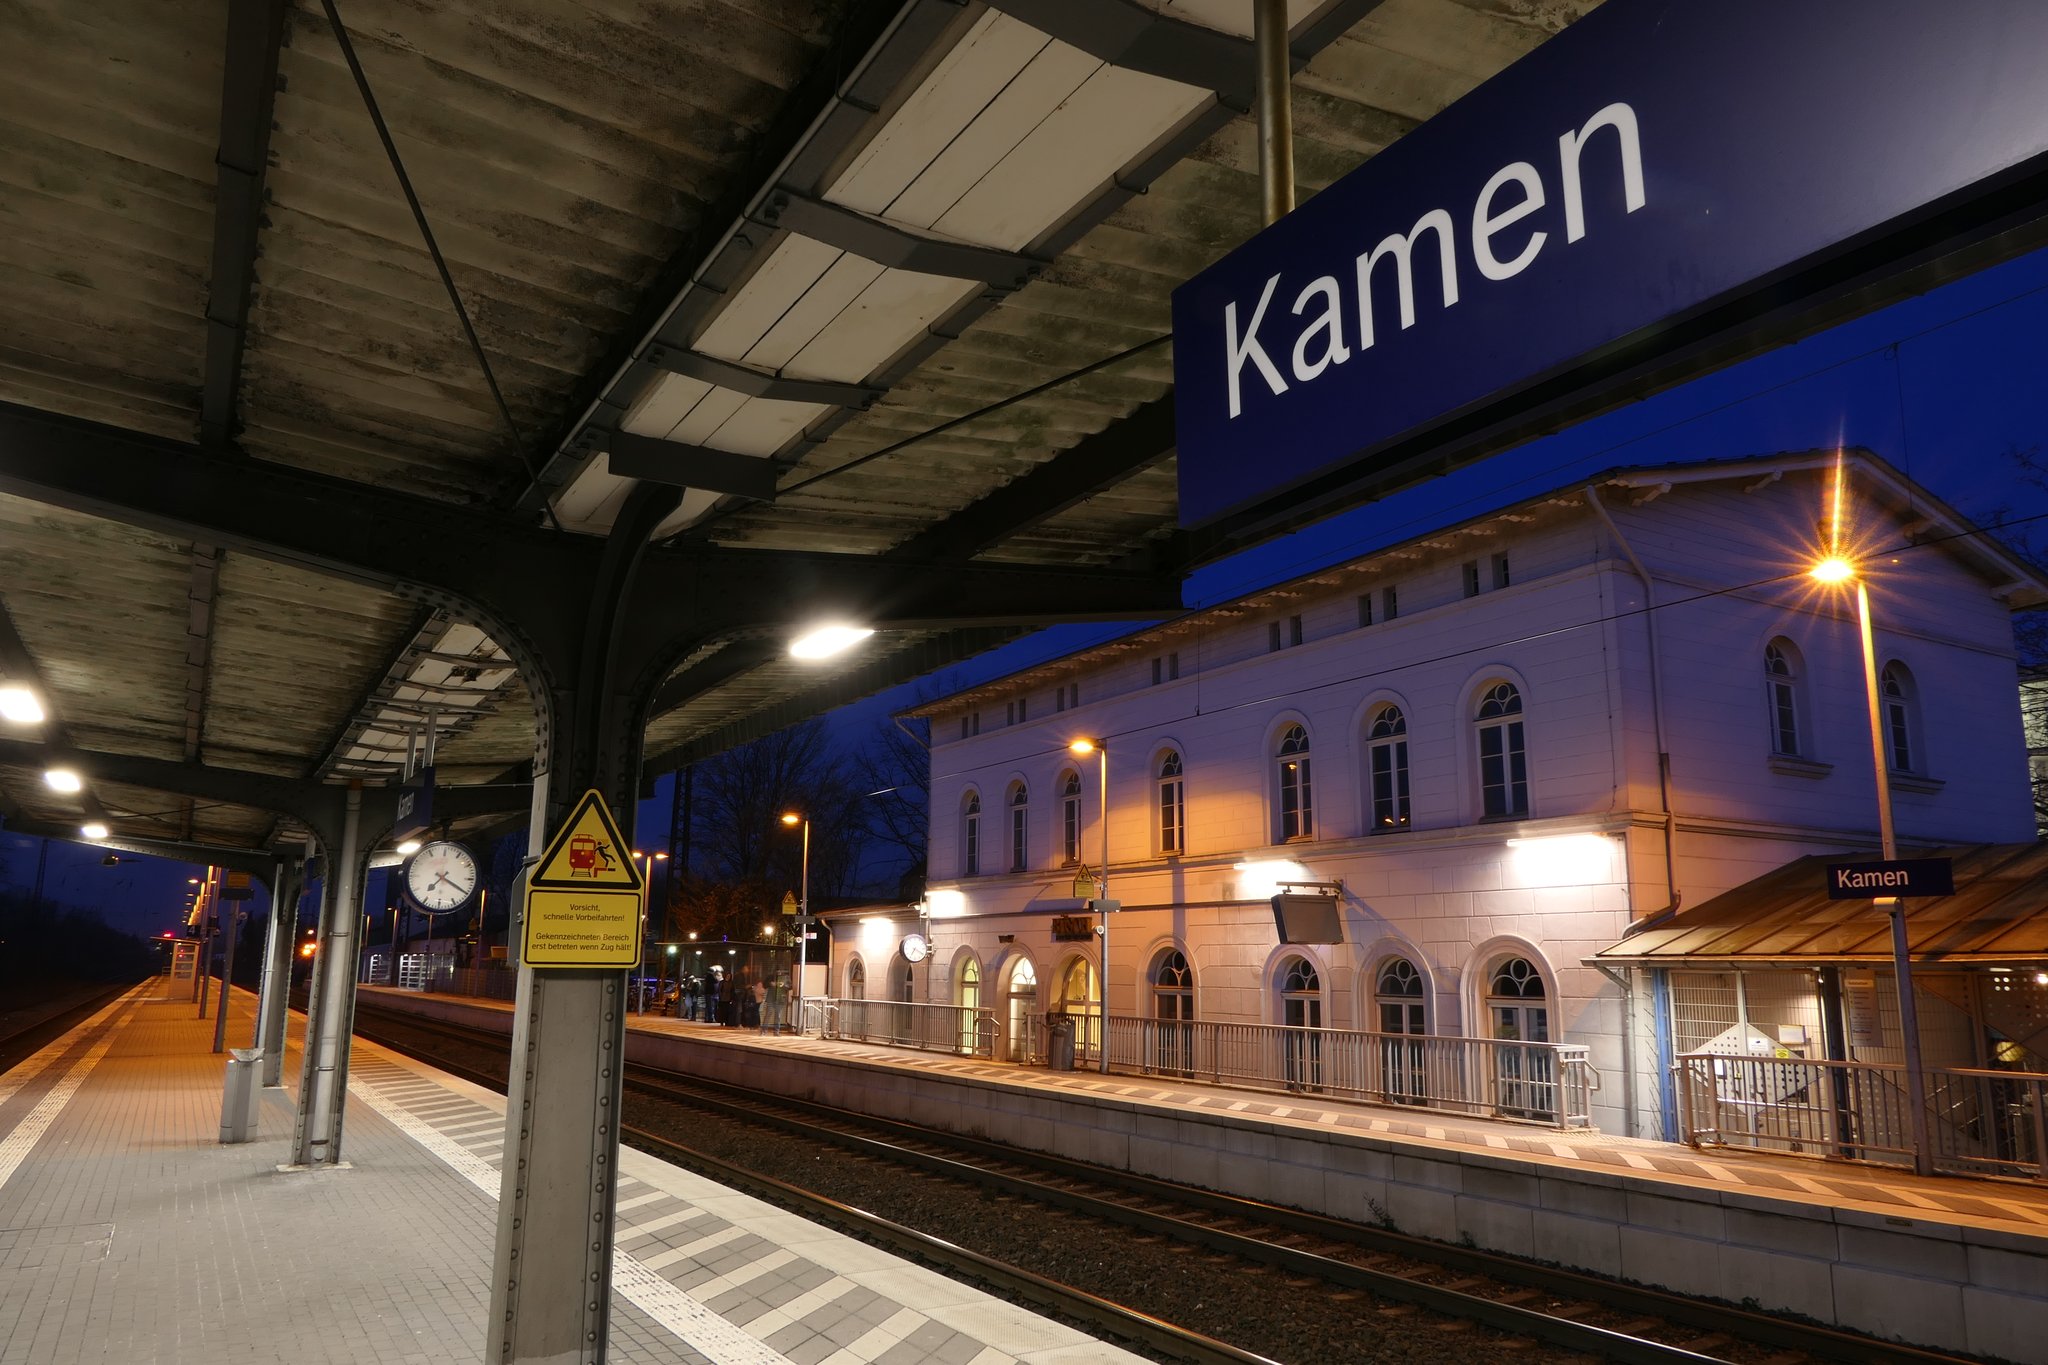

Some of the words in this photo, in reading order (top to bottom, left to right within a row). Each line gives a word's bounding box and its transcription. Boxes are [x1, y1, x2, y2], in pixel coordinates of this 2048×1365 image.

[1225, 101, 1646, 419] Kamen
[1837, 869, 1909, 888] Kamen
[569, 904, 601, 912] Vorsicht,
[543, 913, 574, 921] schnelle
[576, 914, 625, 922] Vorbeifahrten!
[547, 943, 578, 951] betreten
[600, 943, 614, 952] Zug
